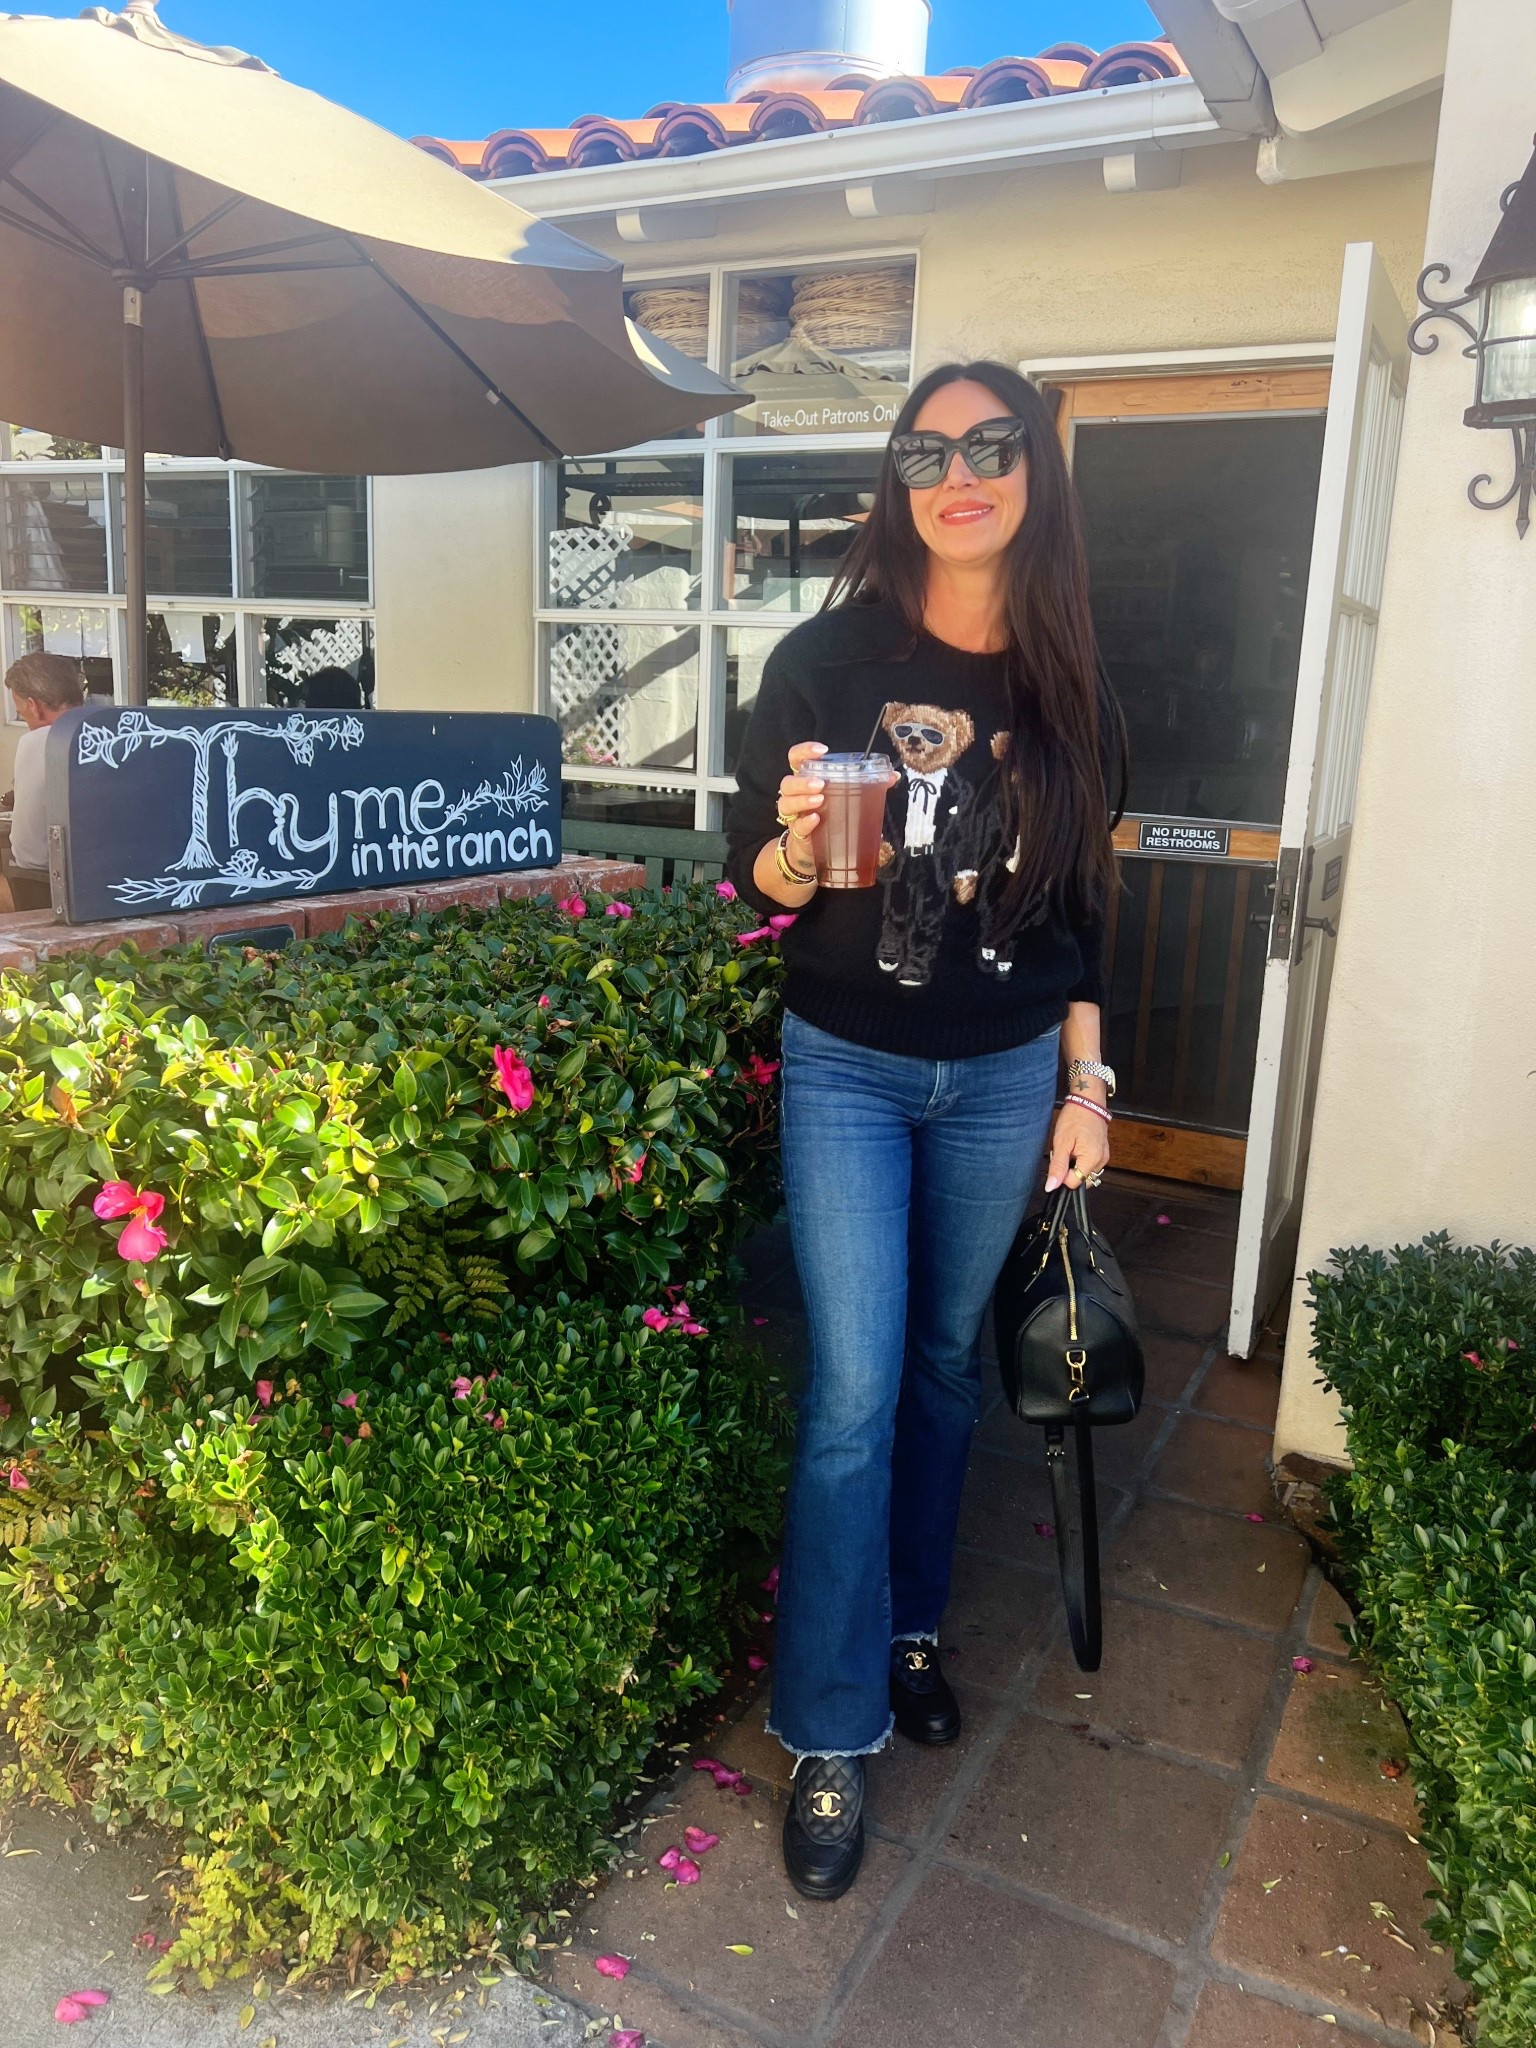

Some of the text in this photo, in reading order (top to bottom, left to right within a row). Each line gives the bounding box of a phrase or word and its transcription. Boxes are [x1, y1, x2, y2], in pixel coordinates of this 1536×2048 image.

[761, 409, 818, 428] Take-Out
[822, 407, 869, 425] Patrons
[79, 711, 452, 908] Thyme
[1146, 836, 1220, 850] RESTROOMS
[1152, 827, 1216, 839] NO PUBLIC
[352, 818, 553, 877] in the ranch
